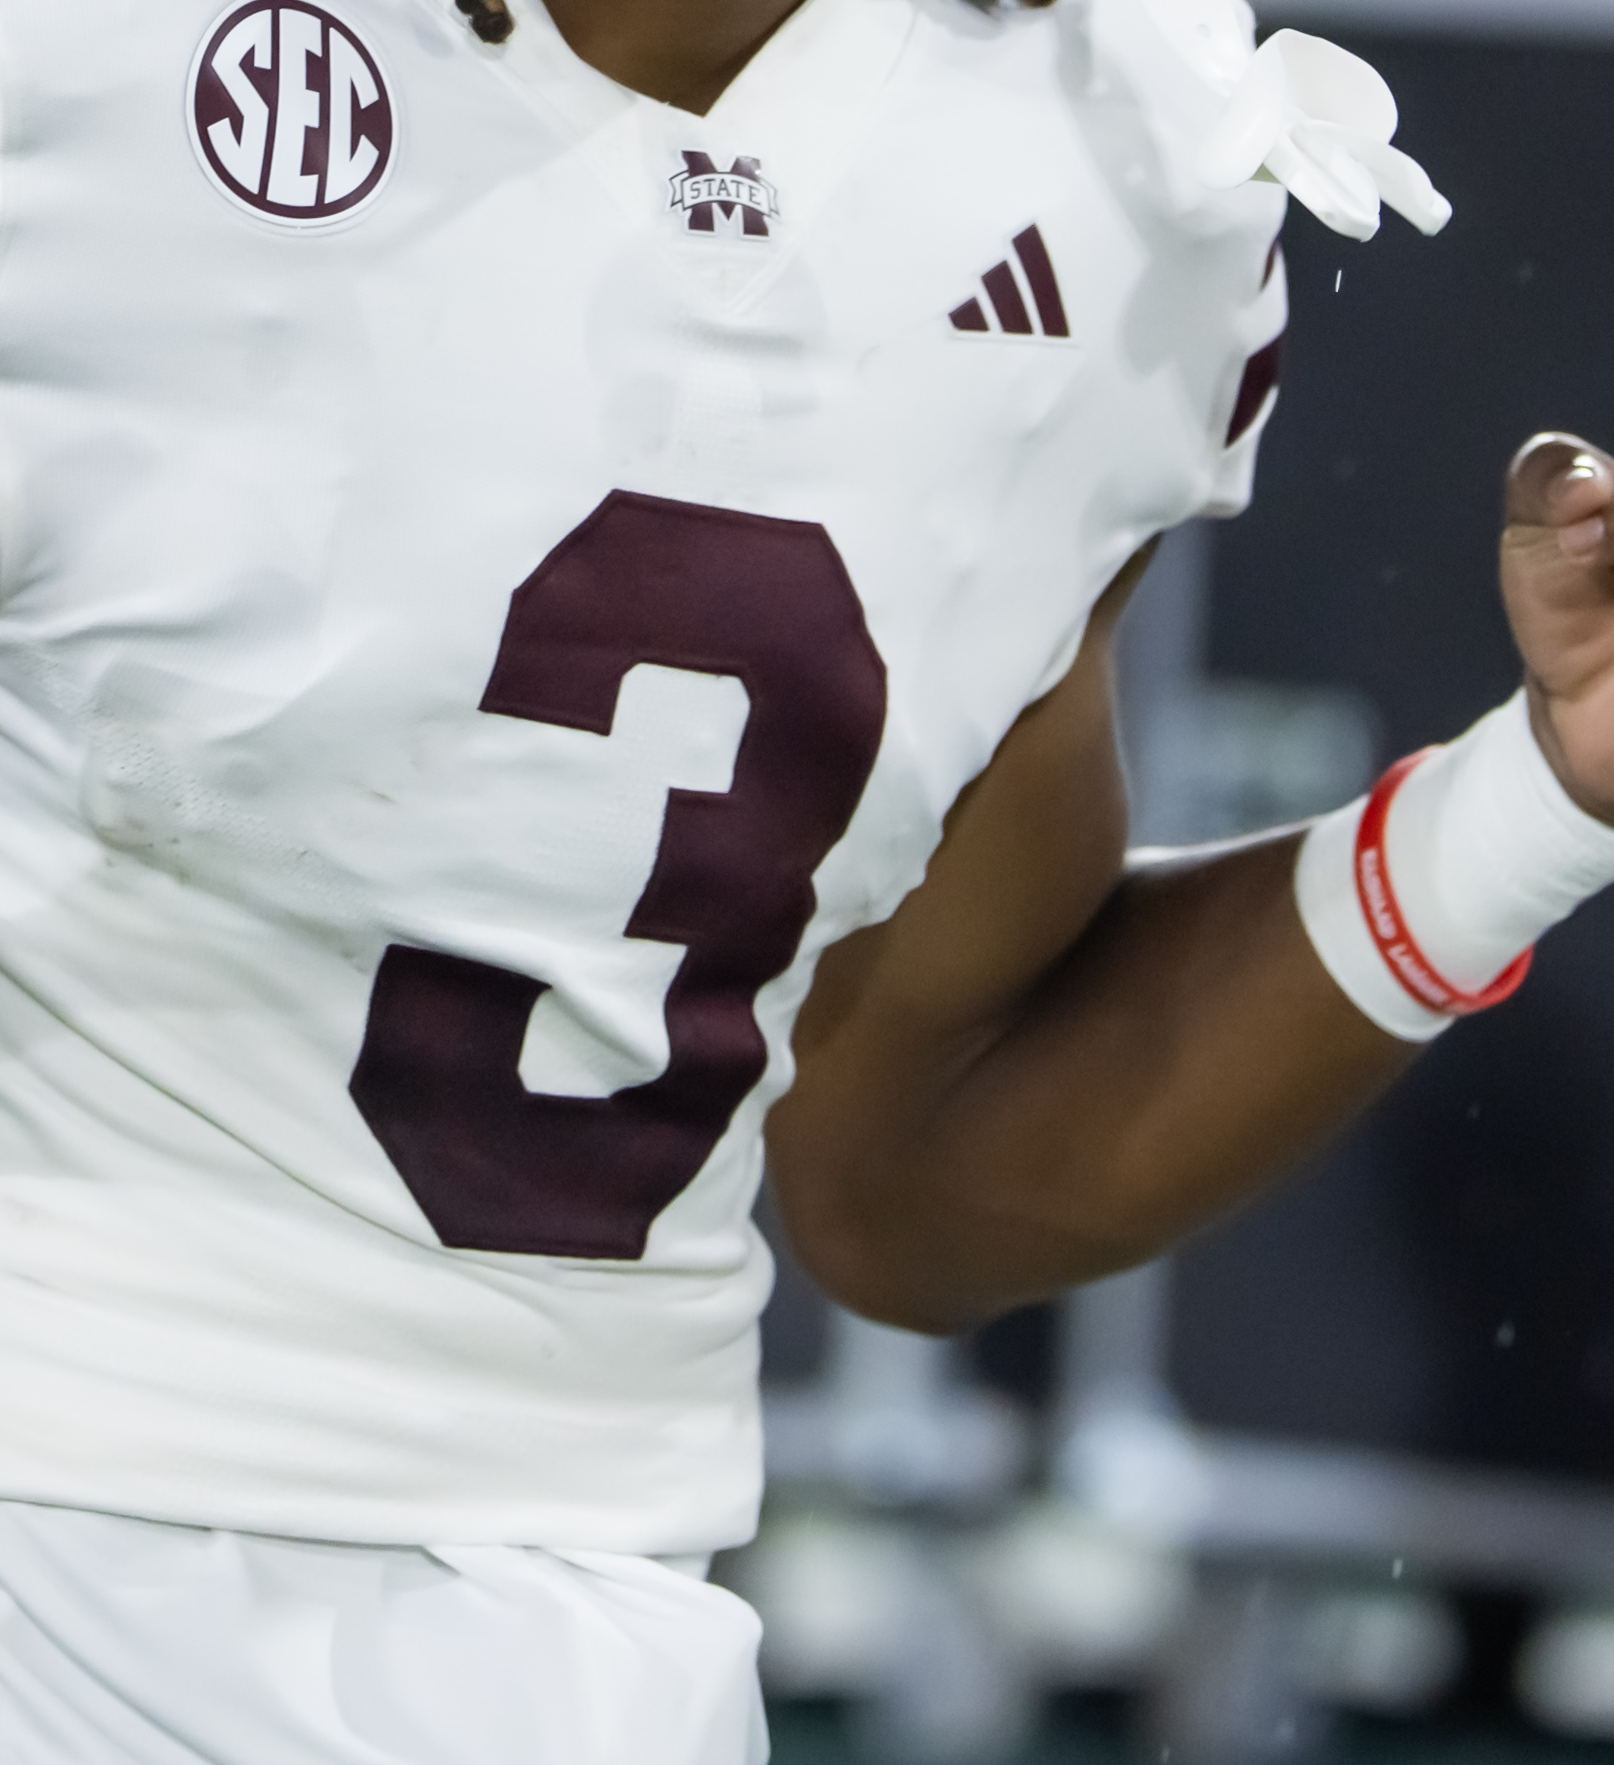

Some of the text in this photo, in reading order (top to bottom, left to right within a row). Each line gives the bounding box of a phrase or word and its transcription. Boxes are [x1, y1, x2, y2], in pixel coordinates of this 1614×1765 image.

[206, 7, 381, 207] SEC
[690, 178, 762, 206] STATE
[349, 487, 889, 1260] 3
